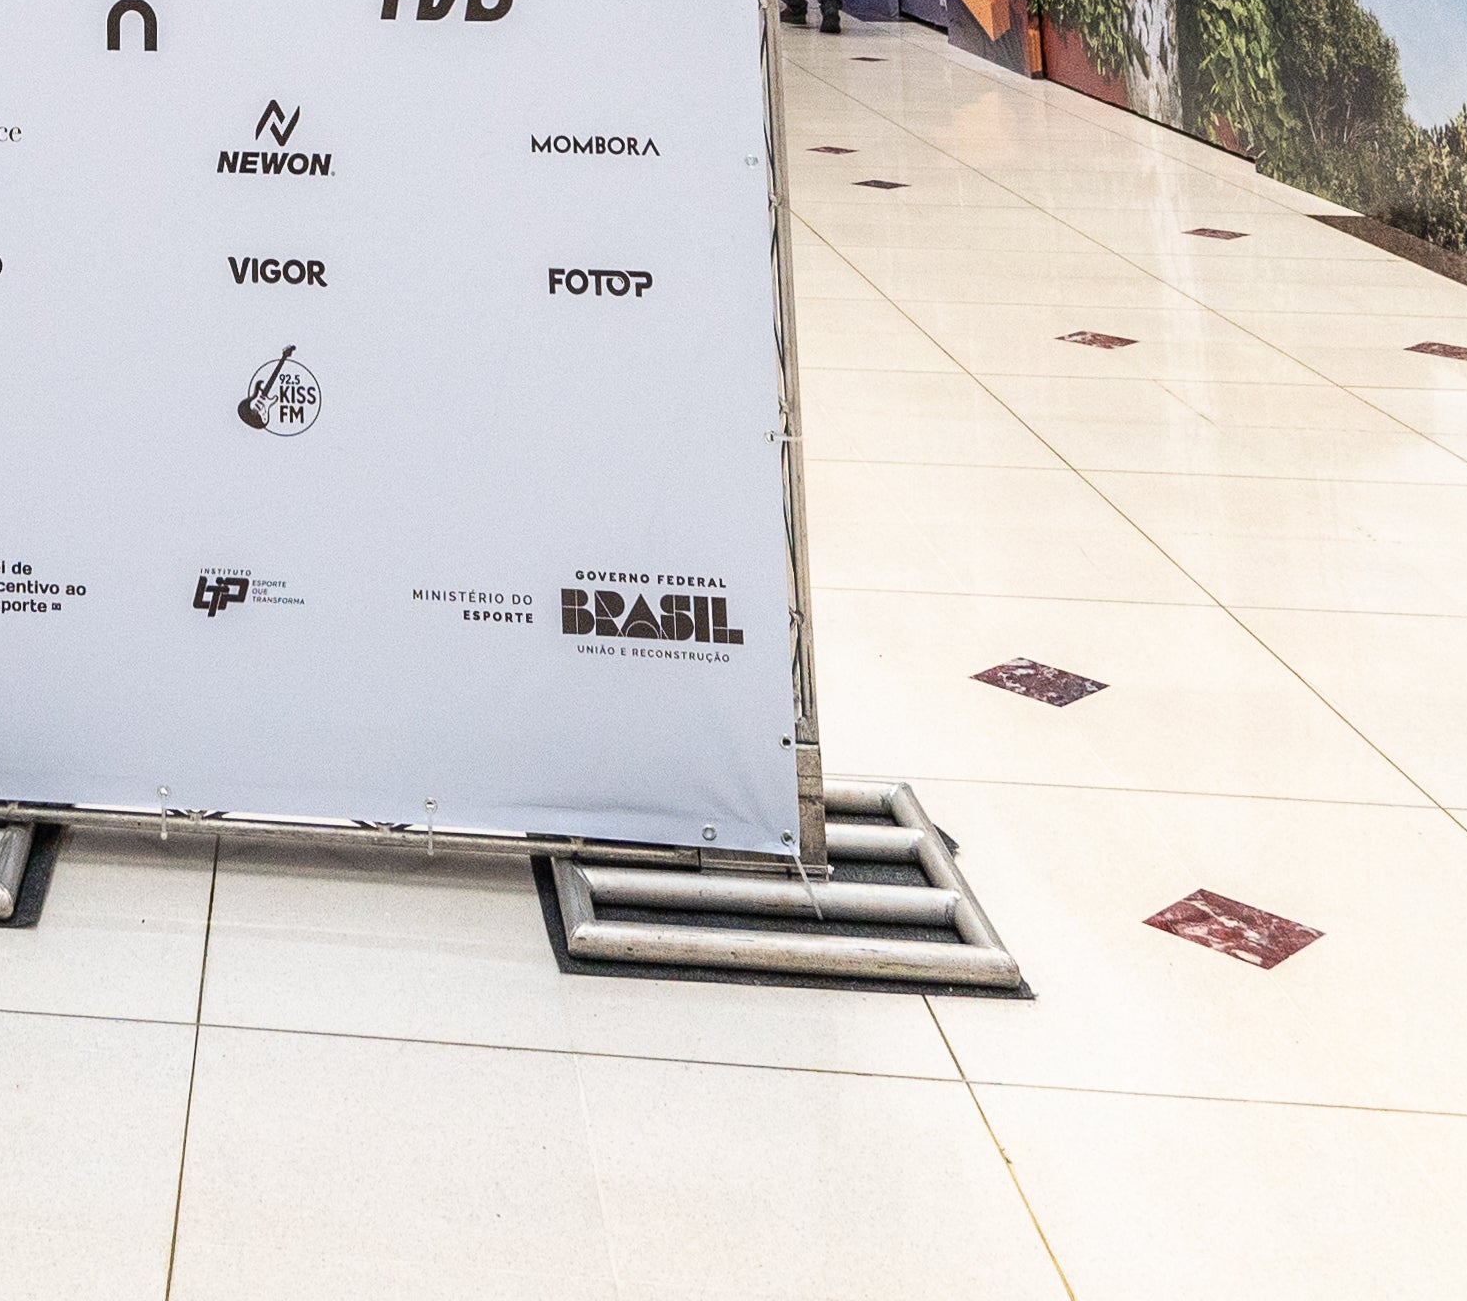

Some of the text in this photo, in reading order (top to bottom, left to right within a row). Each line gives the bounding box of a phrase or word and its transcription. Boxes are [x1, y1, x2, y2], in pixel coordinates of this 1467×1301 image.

[531, 135, 660, 156] MOMBORA
[217, 151, 334, 176] NEWON
[227, 256, 328, 287] VIGOR
[548, 268, 653, 298] FOTOP
[279, 373, 301, 386] 92.5
[279, 385, 317, 406] KISS
[280, 405, 304, 424] FM
[11, 561, 32, 575] de
[199, 568, 252, 577] INSTITUTO
[252, 580, 286, 588] ESPORTE
[575, 570, 726, 588] GOVERNO FEDERAL
[65, 585, 86, 596] ao
[413, 589, 532, 605] MINISTÉRIO DO
[253, 596, 304, 604] TRANSFORMA
[463, 610, 533, 624] ESPORTE
[561, 588, 744, 647] BRASIL
[577, 645, 729, 663] UNIÃO RECONSTRUÇÃO
